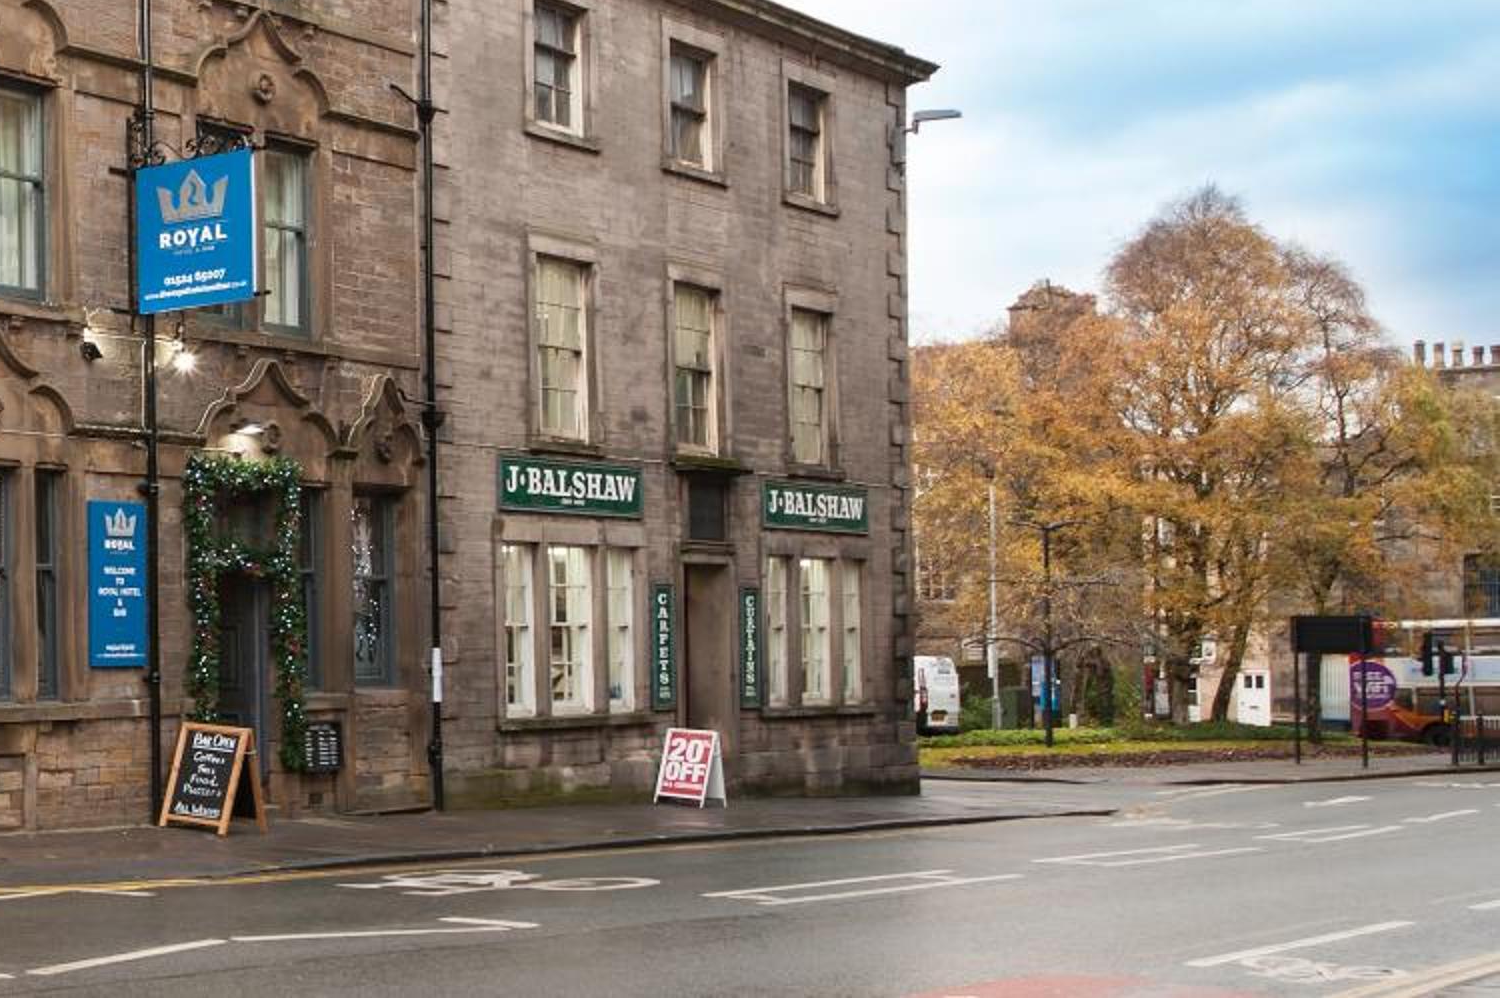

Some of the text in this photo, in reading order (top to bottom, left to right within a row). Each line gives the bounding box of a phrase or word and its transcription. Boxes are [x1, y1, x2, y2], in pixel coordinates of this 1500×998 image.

[159, 223, 228, 249] ROYAL
[657, 593, 669, 685] CARPETS
[745, 595, 756, 684] CURTAINS
[665, 761, 706, 783] OFF
